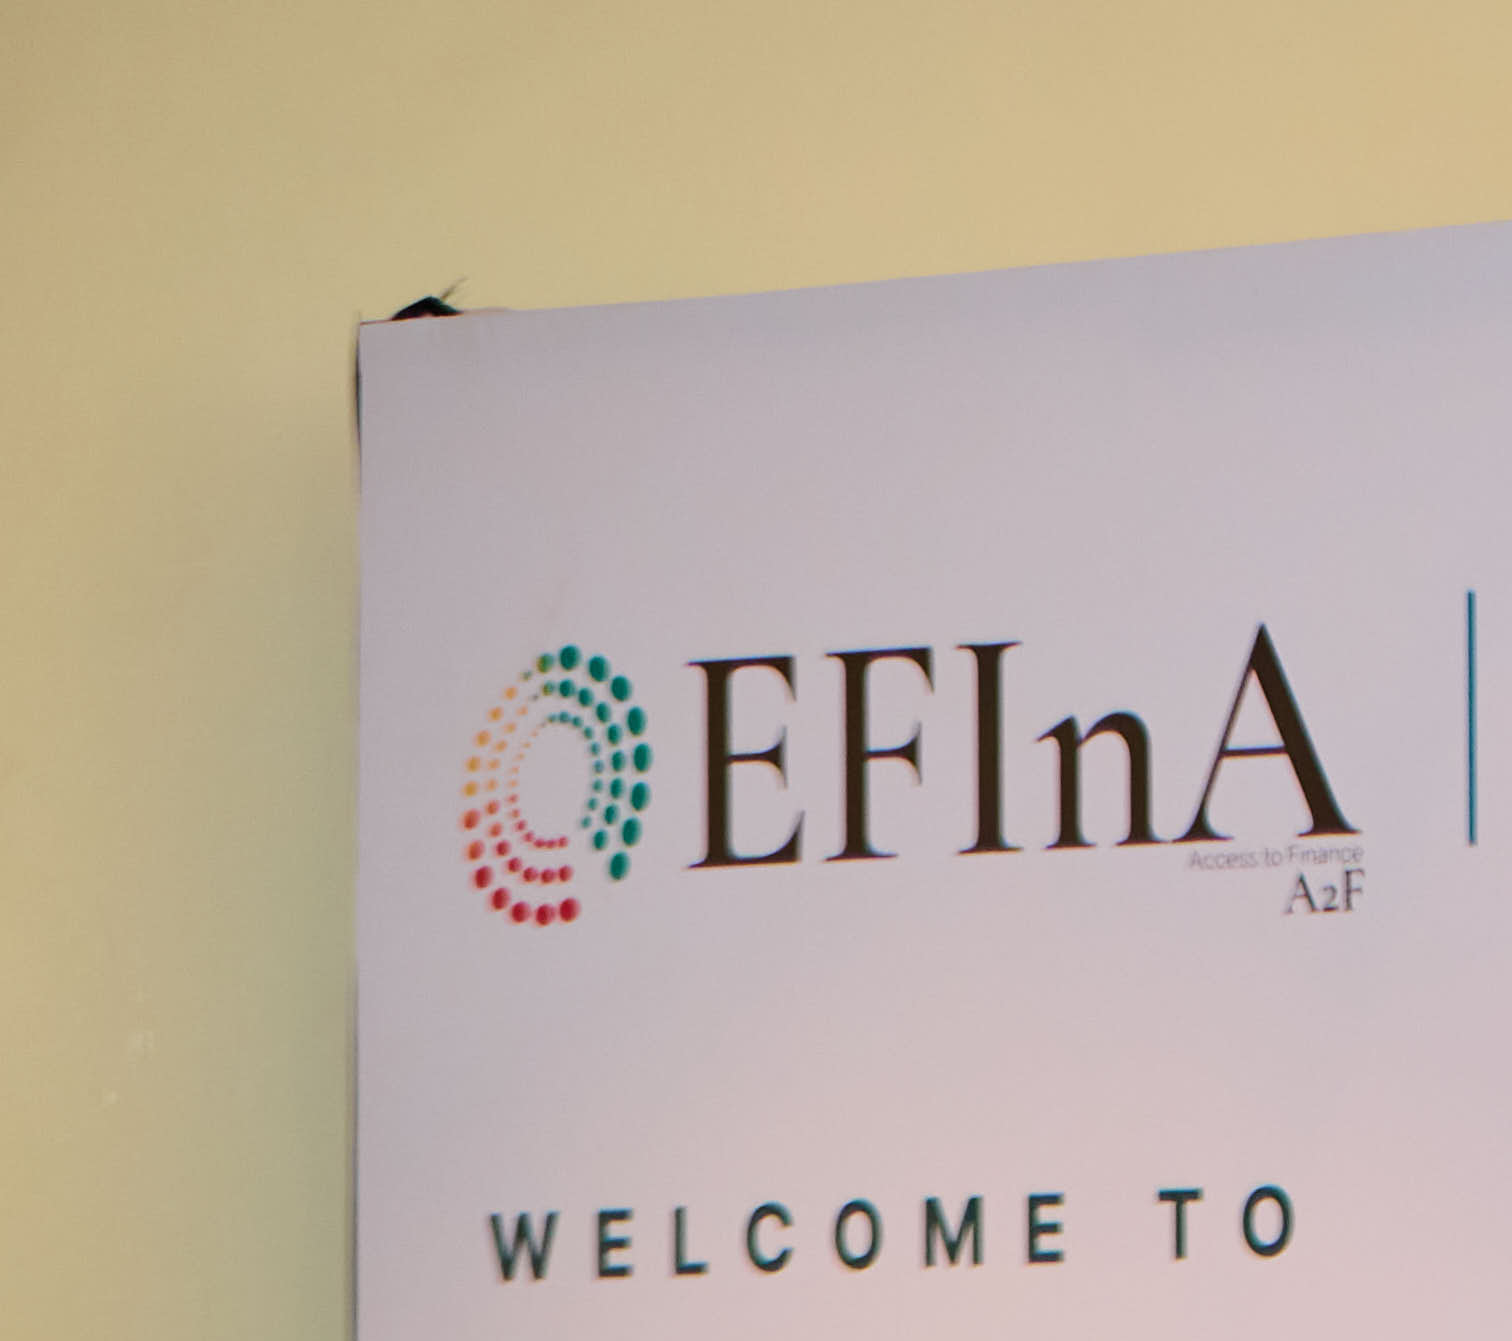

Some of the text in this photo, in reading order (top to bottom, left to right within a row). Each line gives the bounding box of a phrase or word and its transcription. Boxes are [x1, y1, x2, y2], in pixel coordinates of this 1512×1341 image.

[684, 622, 1361, 870] EFInA
[1189, 844, 1365, 869] Access to Finance
[1285, 868, 1365, 915] A2F
[486, 1184, 1295, 1284] WELCOME TO
